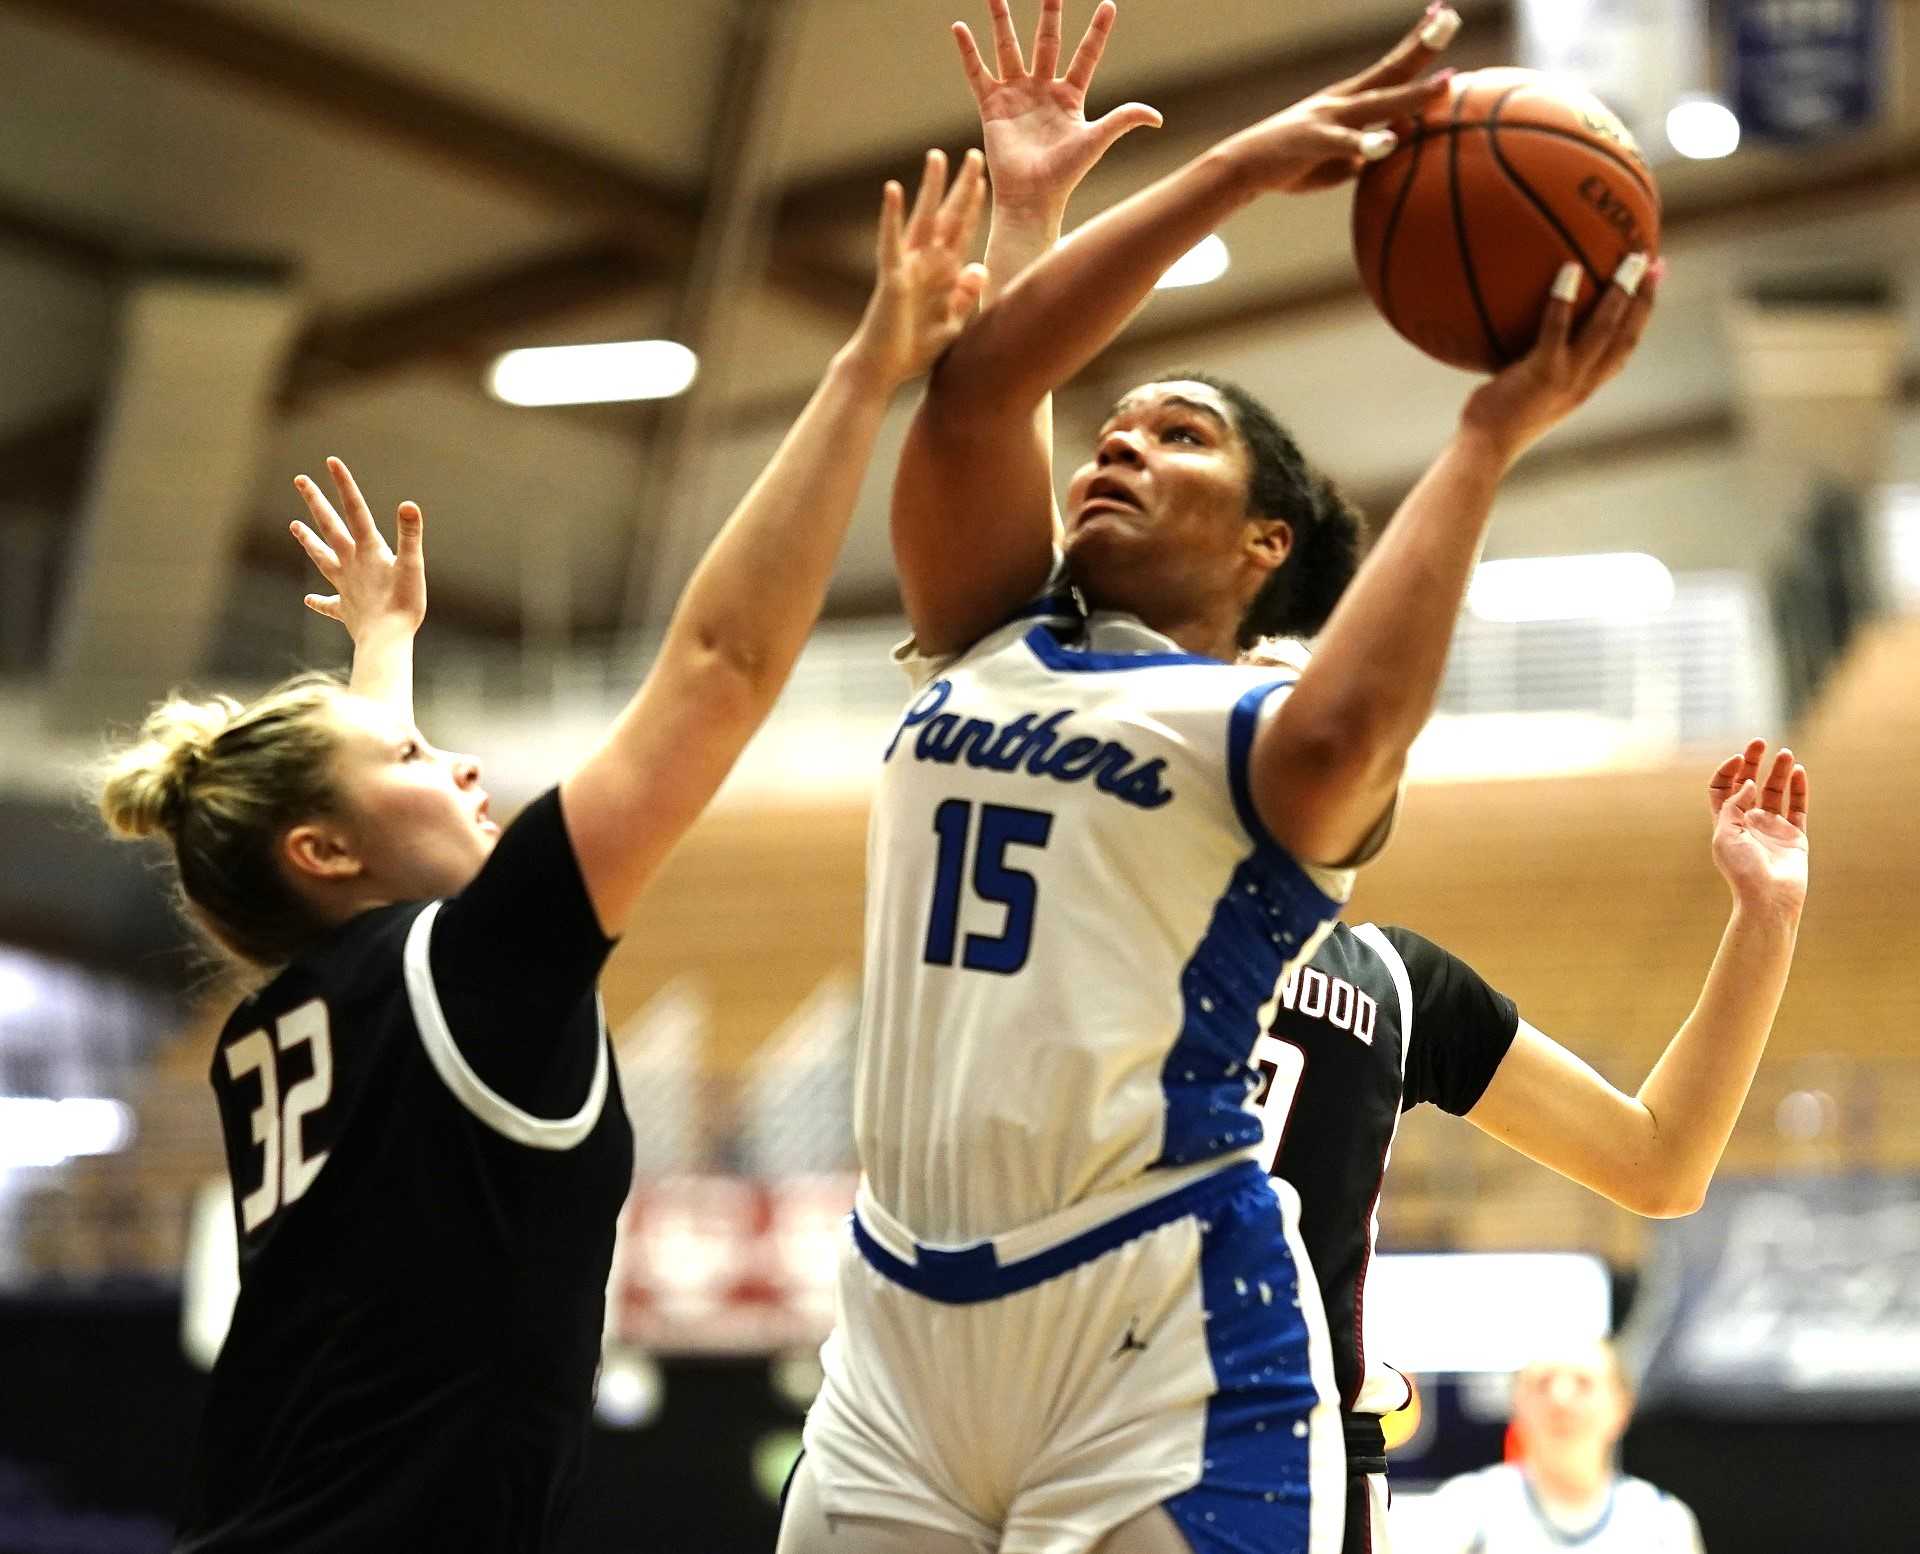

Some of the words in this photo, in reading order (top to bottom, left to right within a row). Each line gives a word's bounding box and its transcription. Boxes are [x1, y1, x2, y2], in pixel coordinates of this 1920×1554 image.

[884, 679, 1174, 809] Panthers
[924, 797, 1054, 976] 15
[224, 997, 332, 1234] 32
